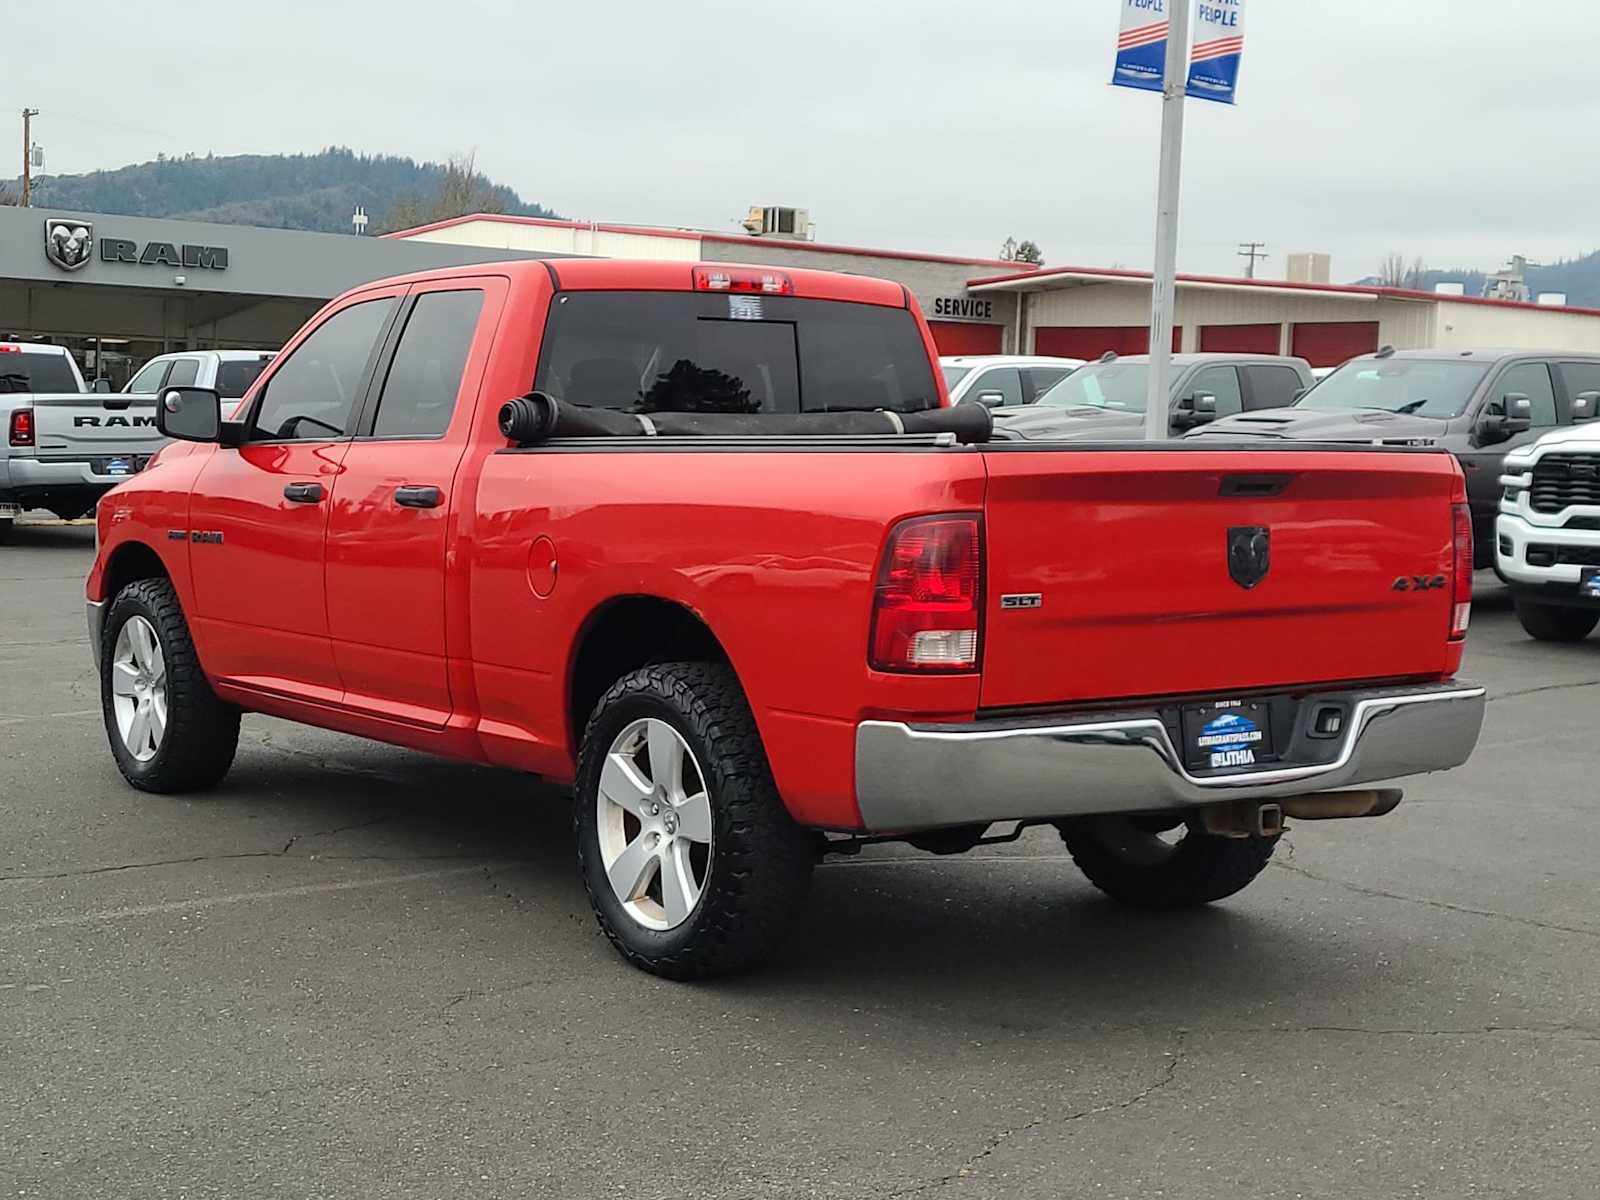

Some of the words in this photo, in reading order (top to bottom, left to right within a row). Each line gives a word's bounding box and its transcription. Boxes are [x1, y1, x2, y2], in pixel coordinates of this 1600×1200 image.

[1199, 4, 1238, 27] PEOPLE
[101, 237, 228, 269] RAM
[935, 297, 992, 318] SERVICE
[74, 416, 157, 427] RAM
[1002, 594, 1041, 608] SLT
[1222, 749, 1255, 767] LITHIA
